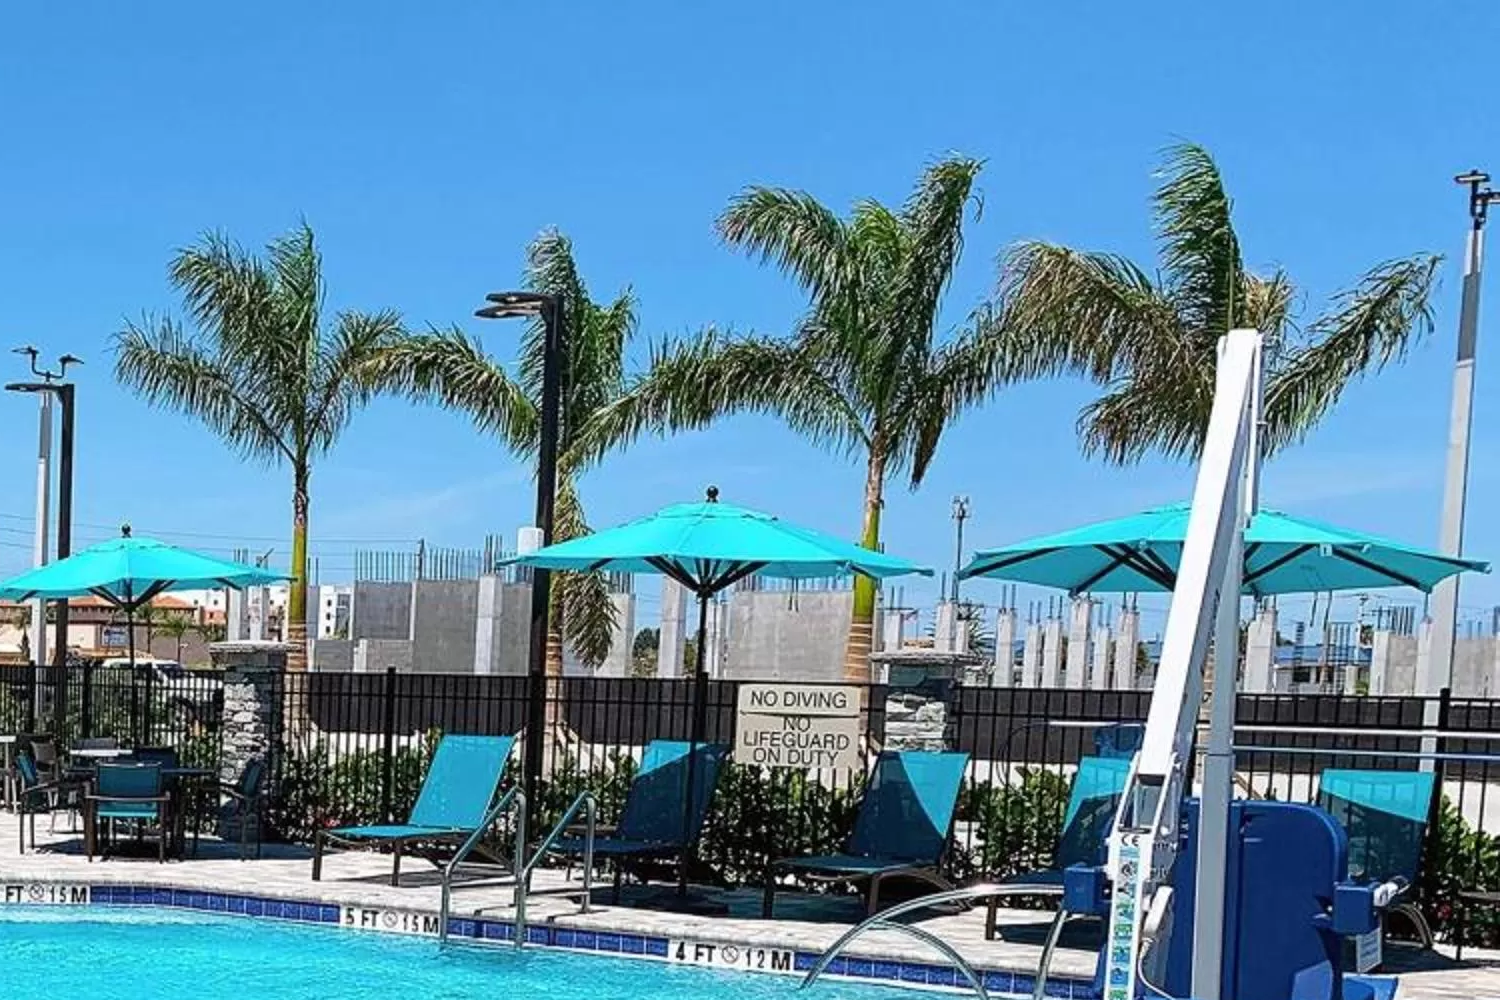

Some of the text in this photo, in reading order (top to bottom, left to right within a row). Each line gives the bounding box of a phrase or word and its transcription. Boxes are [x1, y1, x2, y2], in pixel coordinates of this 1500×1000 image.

[750, 690, 847, 709] NO DIVING
[783, 716, 811, 732] NO
[743, 730, 850, 750] LIFEGUARD
[753, 748, 839, 767] ON DUTY
[6, 886, 24, 902] FT
[345, 907, 355, 925] 5
[361, 909, 379, 927] FT
[675, 941, 686, 961] 4
[694, 944, 716, 962] FT
